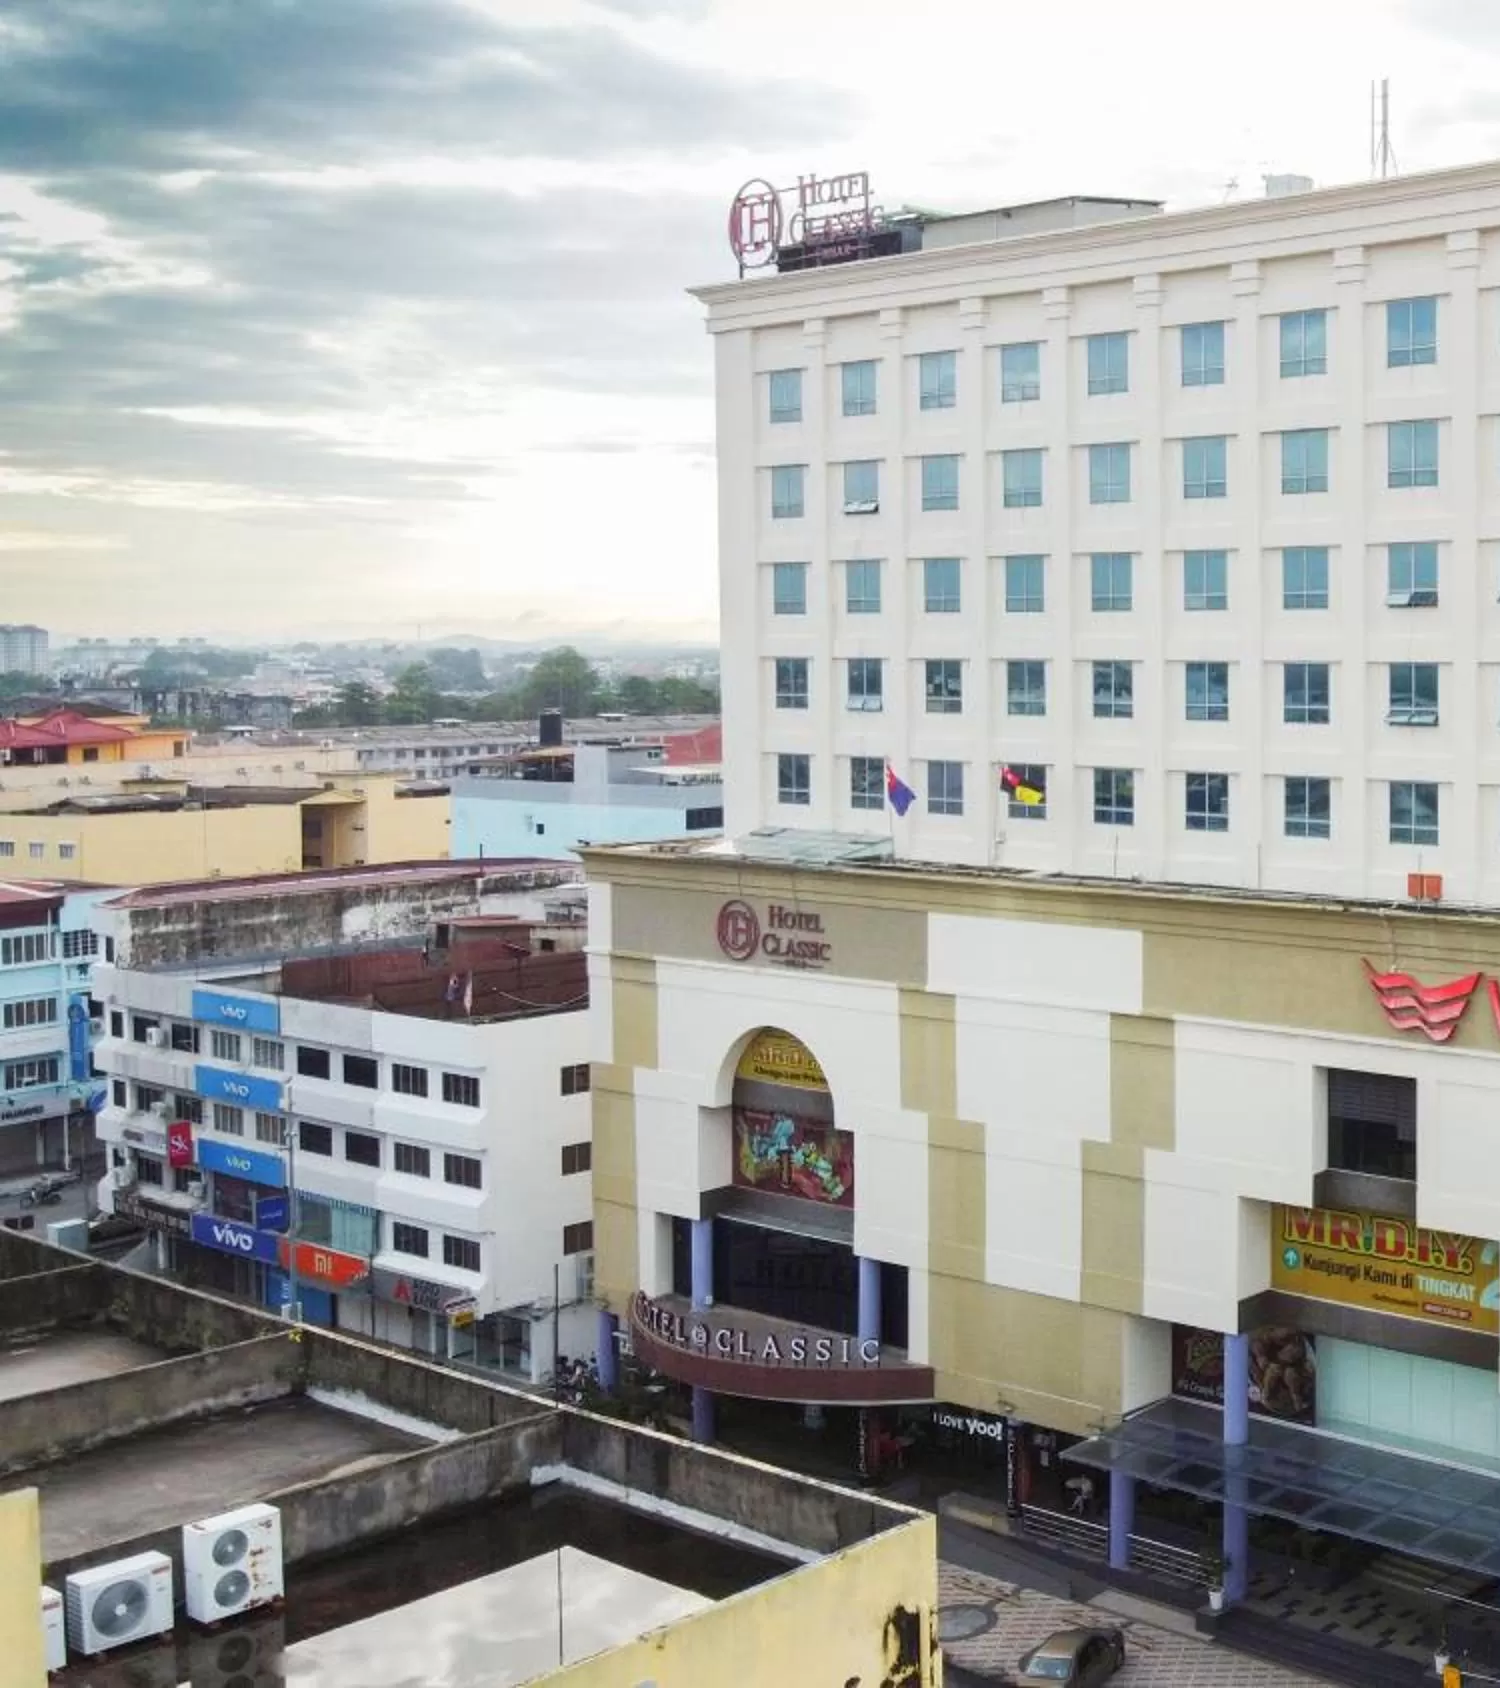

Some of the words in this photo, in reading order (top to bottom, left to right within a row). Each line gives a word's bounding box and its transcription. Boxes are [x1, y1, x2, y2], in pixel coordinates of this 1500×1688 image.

[768, 904, 825, 933] HOTEL
[762, 933, 832, 961] CLASSIC
[212, 1222, 253, 1251] vivo
[1303, 1251, 1361, 1282] Kunjungi
[1363, 1264, 1397, 1287] Kami
[1400, 1269, 1413, 1289] di
[1417, 1275, 1476, 1301] TINGKAT
[714, 1328, 880, 1364] CLASSIC
[940, 1413, 963, 1431] LOVE
